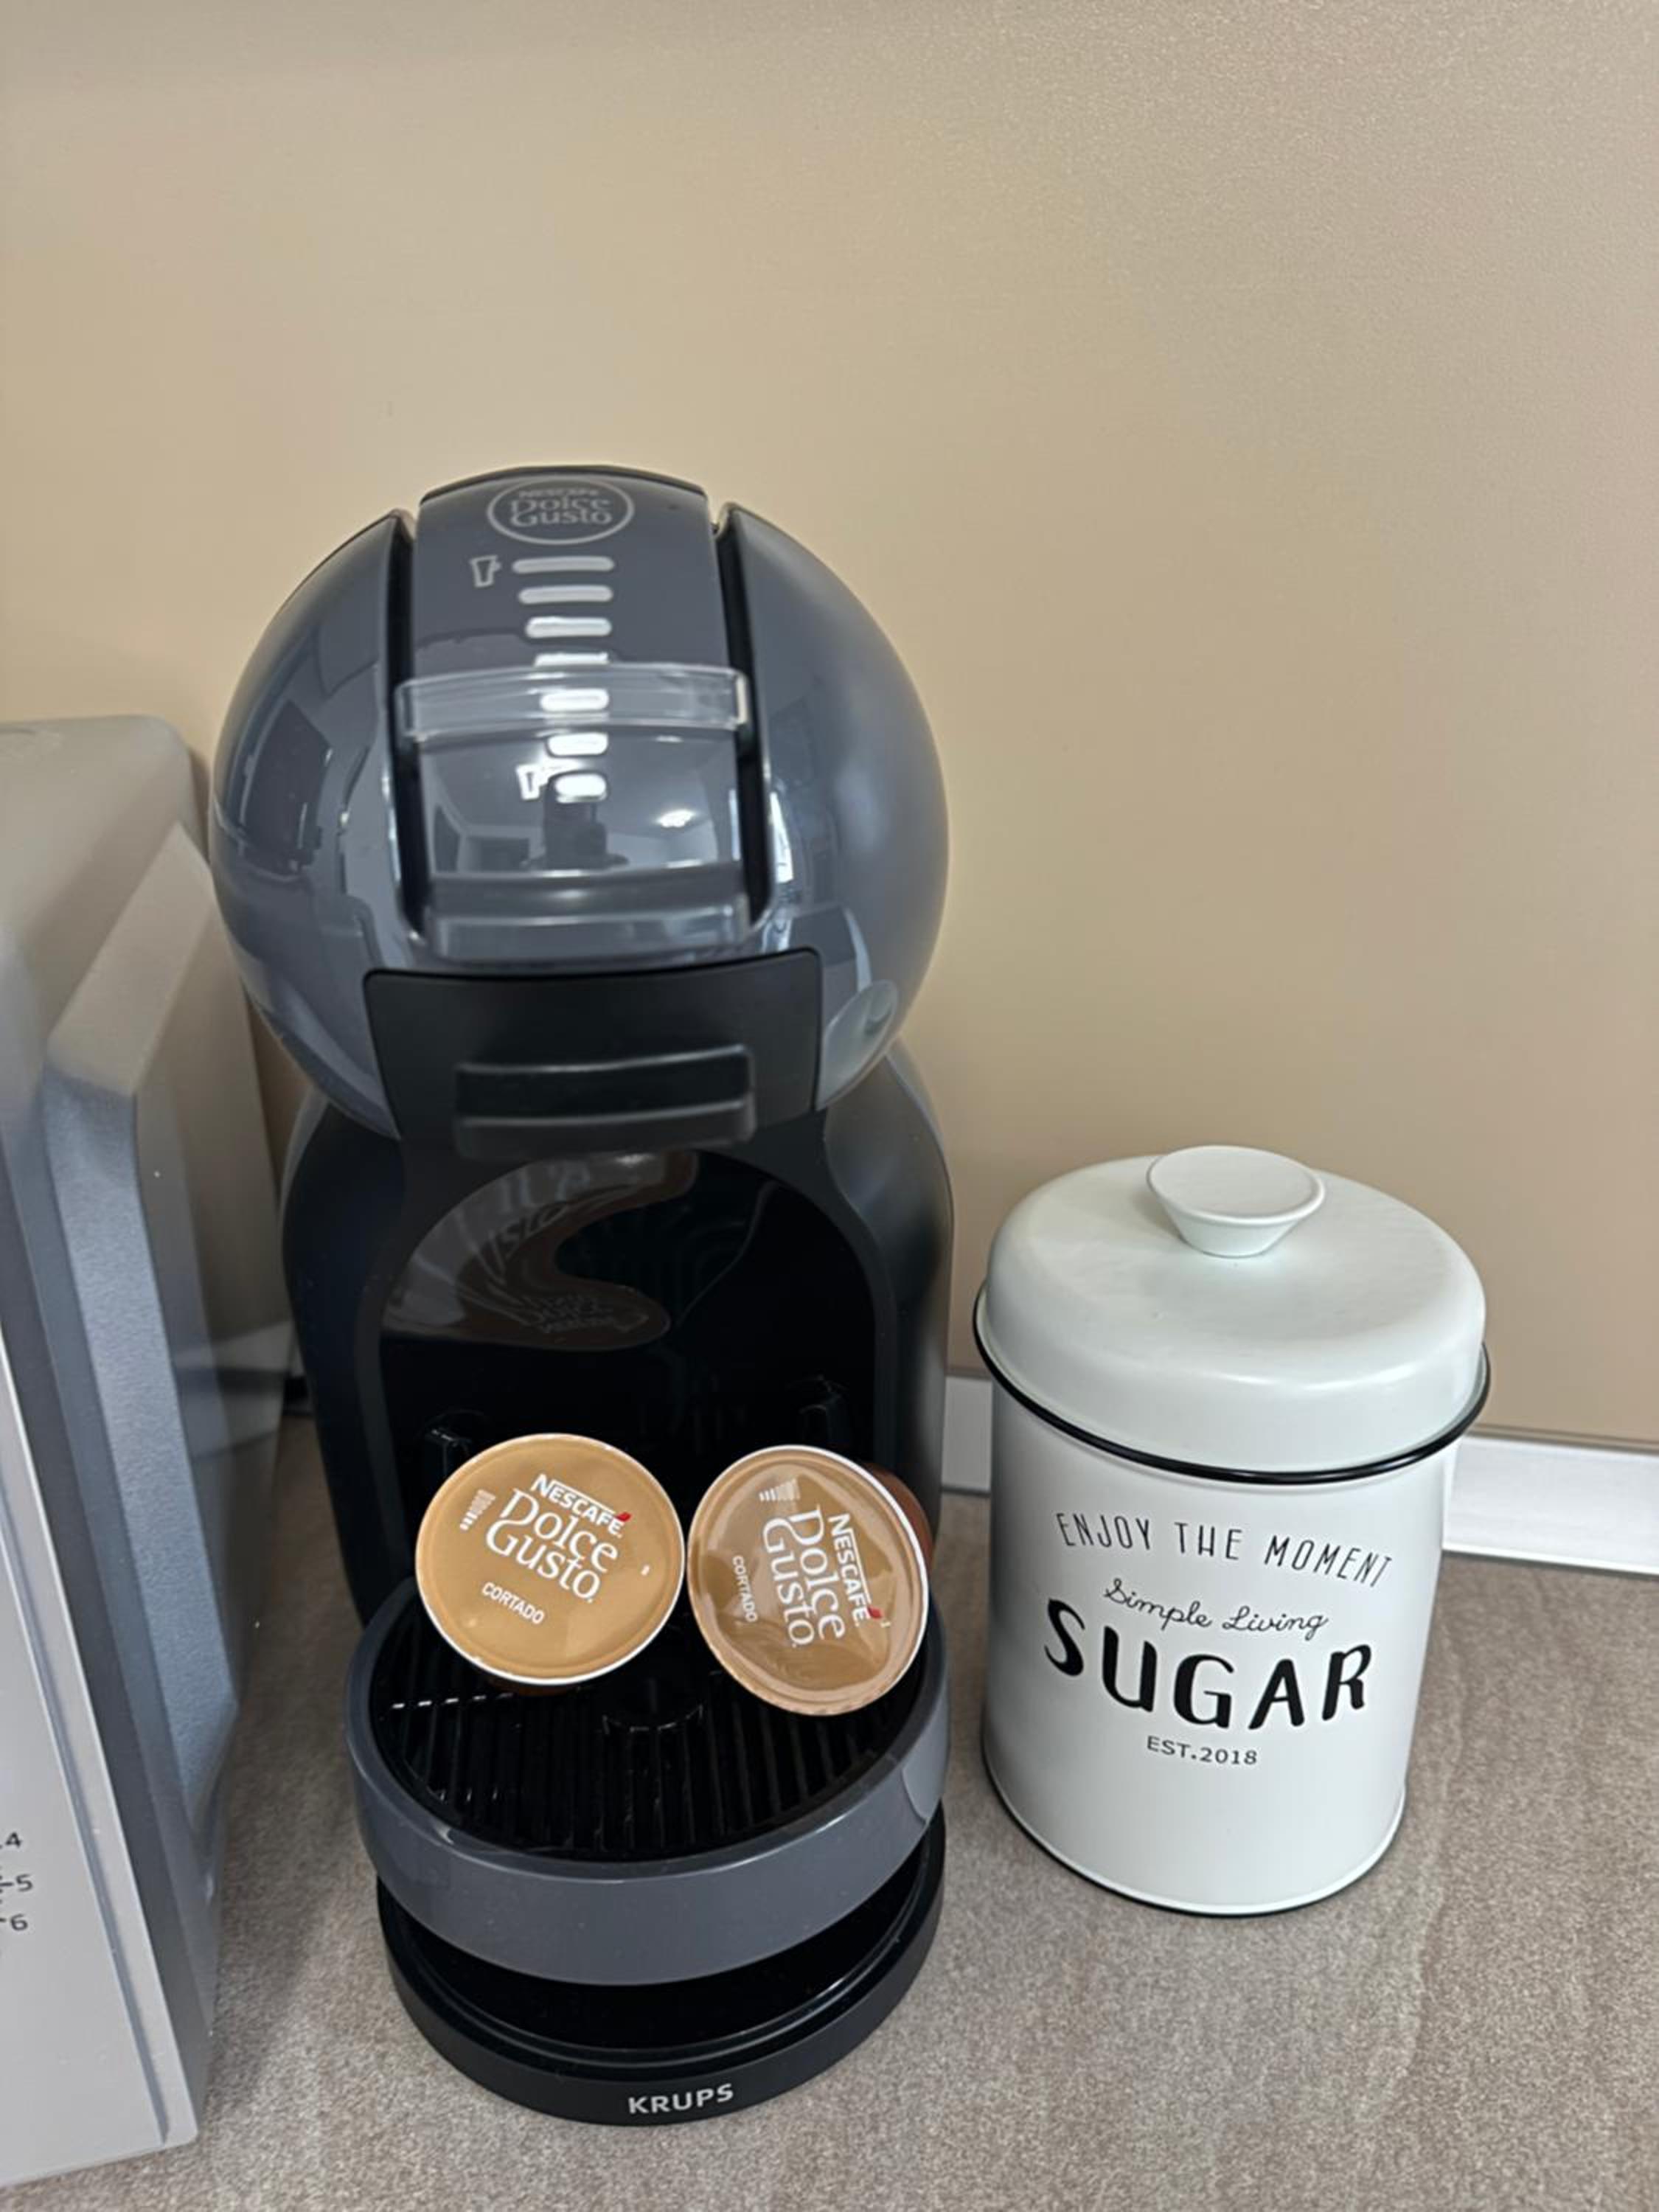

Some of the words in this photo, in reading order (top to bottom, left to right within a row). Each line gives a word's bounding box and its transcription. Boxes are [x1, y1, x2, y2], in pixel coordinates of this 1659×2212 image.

[510, 509, 612, 527] Gusto
[500, 1488, 619, 1573] Dolce
[1056, 1512, 1152, 1551] ENJOY
[1174, 1521, 1243, 1560] THE
[1264, 1534, 1394, 1588] MOMENT
[485, 1520, 602, 1603] Gusto
[786, 1503, 846, 1640] Dolce
[481, 1582, 546, 1625] CORTADO
[732, 1555, 759, 1623] CORTADO
[1103, 1577, 1214, 1632] Simple
[1221, 1605, 1329, 1641] Living
[1043, 1597, 1372, 1731] SUGAR
[1146, 1735, 1258, 1766] EST.2018
[5, 1832, 22, 1849] 4
[15, 1874, 34, 1893] 5
[10, 1913, 29, 1931] 6
[628, 2083, 734, 2114] KRUPS
